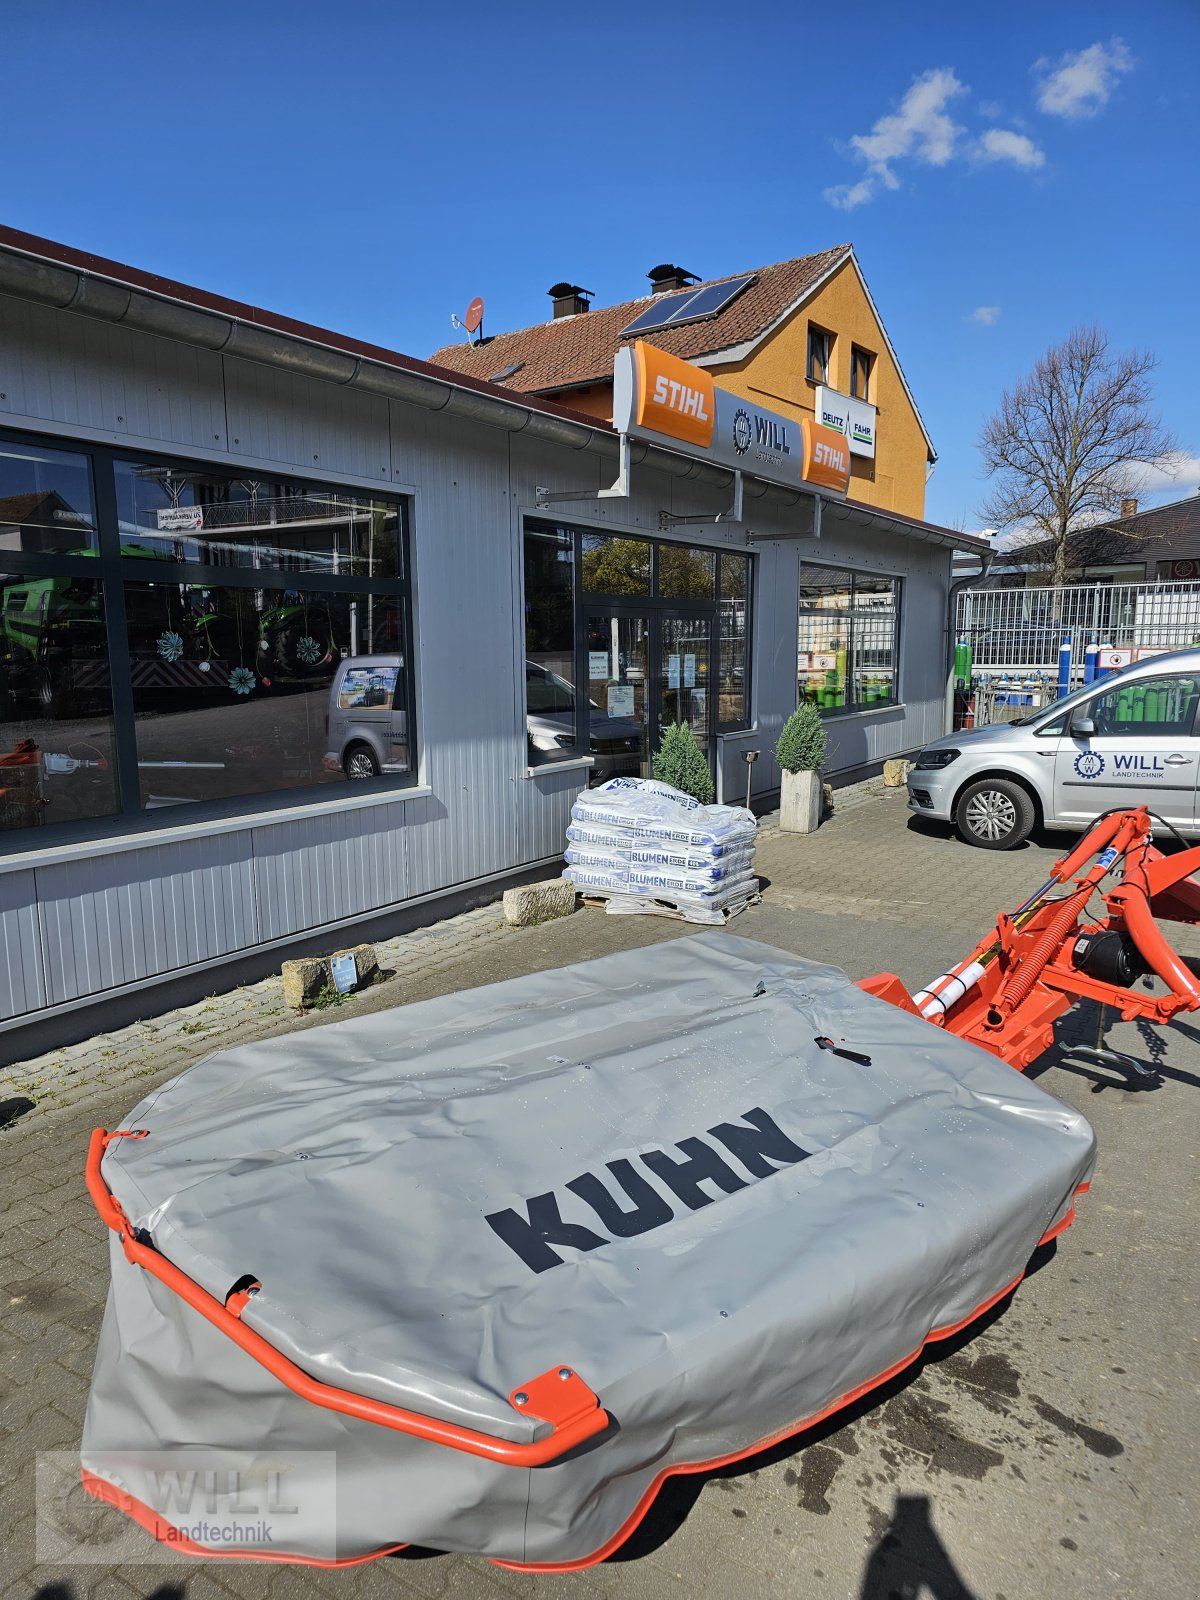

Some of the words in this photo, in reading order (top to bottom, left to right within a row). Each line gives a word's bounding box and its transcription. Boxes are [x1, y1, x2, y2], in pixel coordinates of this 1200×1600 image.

[653, 375, 708, 420] STIHL
[822, 411, 844, 427] DEUTZ
[854, 423, 871, 436] FAHR
[754, 415, 791, 455] WILL
[814, 442, 845, 472] STIHL
[1113, 754, 1165, 771] WILL
[1112, 771, 1165, 779] LANDTECHNIK
[584, 811, 619, 824] BLUMEN
[582, 830, 617, 846] BLUMEN
[634, 828, 672, 840] BLUMEN
[580, 855, 615, 869] BLUMEN
[632, 852, 669, 865] BLUMEN
[669, 857, 686, 865] ERDE
[578, 873, 613, 888] BLUMEN
[629, 873, 667, 887] BLUMEN
[484, 1106, 813, 1274] KUHN
